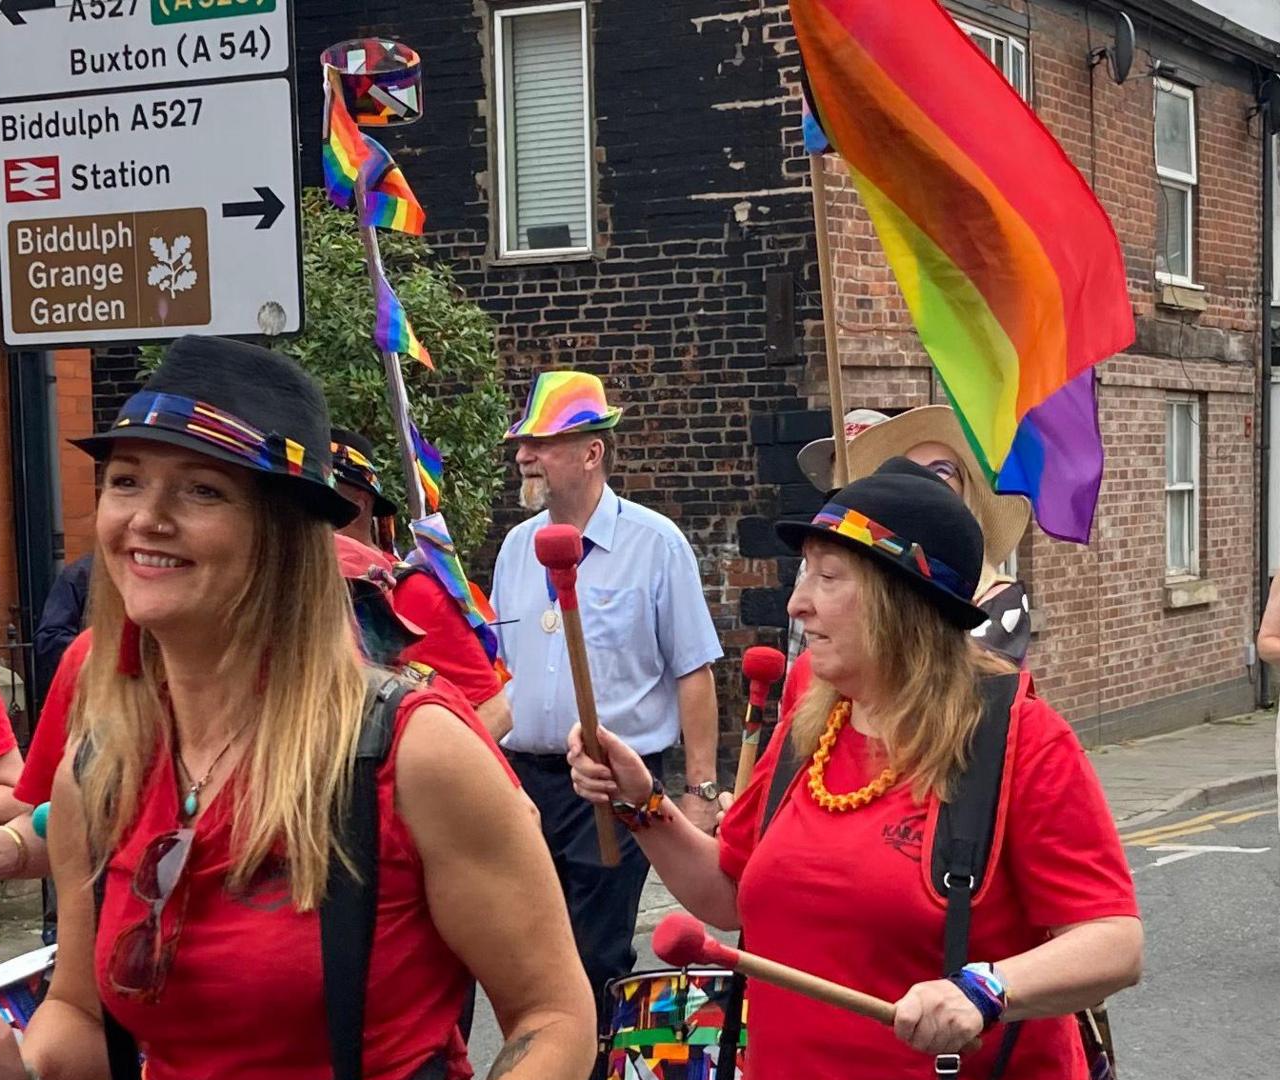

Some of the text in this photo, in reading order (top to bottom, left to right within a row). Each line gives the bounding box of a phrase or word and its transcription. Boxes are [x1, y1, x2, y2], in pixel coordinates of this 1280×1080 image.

[70, 43, 167, 76] Buxton
[1, 98, 203, 142] Biddulph A527
[70, 160, 171, 192] Station
[16, 221, 133, 256] Biddulph
[27, 261, 124, 290] Grange
[30, 297, 125, 325] Garden
